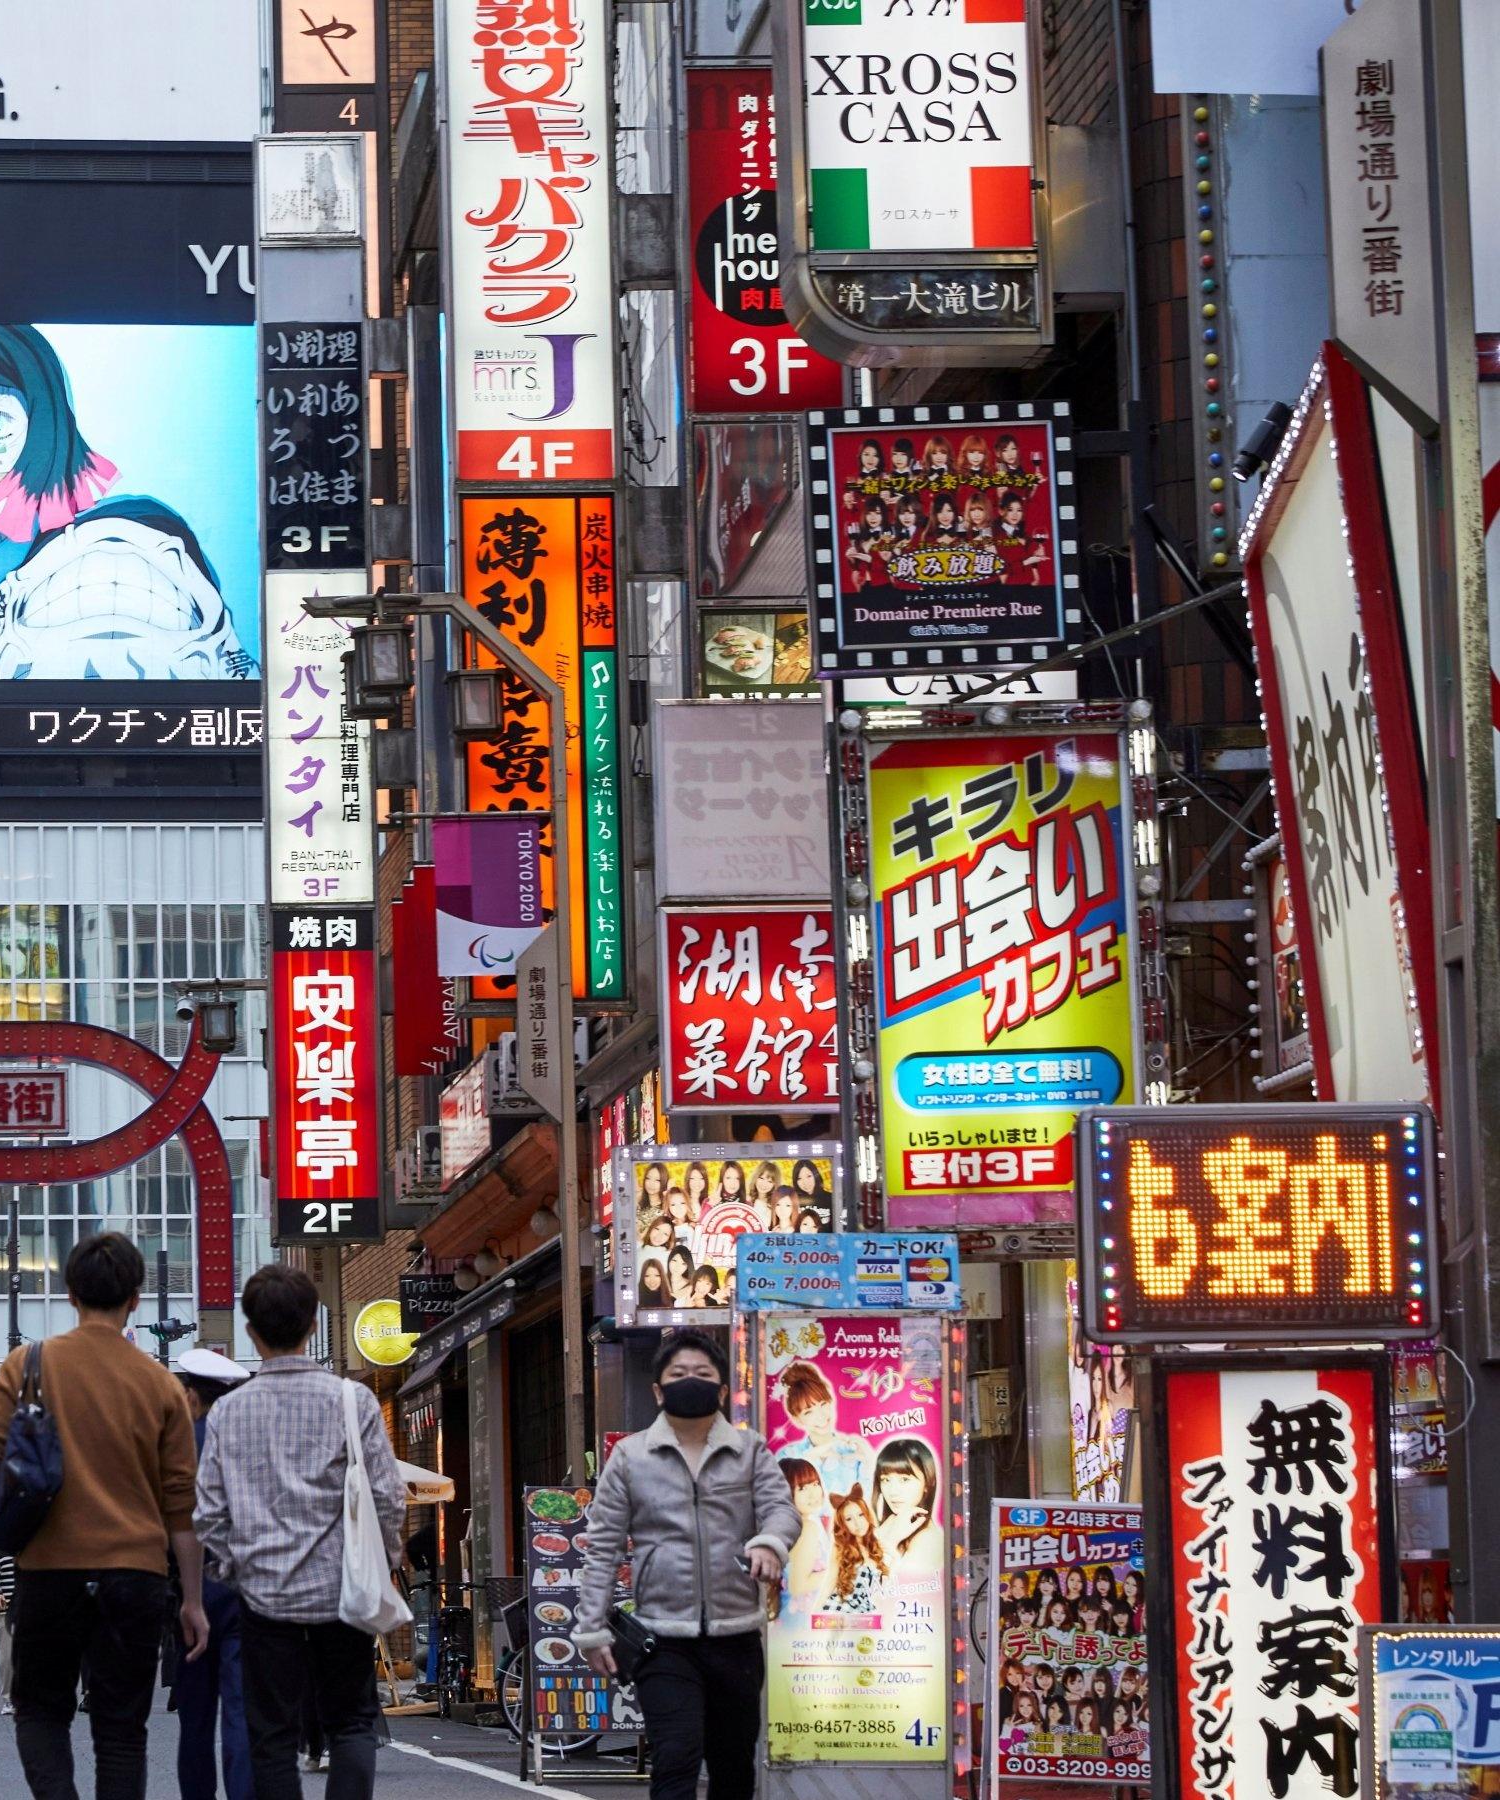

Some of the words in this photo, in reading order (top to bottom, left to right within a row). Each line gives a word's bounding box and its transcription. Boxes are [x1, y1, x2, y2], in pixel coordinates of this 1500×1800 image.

[810, 52, 1018, 96] XROSS
[338, 98, 360, 126] 4
[840, 100, 1001, 144] CASA
[1355, 59, 1404, 317] 劇場通り一番街
[882, 208, 959, 221] クロスカーサ
[838, 281, 1033, 316] 第一大滝ビル
[267, 329, 358, 366] 小料理
[729, 337, 809, 396] 3F
[496, 436, 576, 479] 4F
[281, 526, 350, 553] 3F
[583, 514, 614, 630] 炭火串焼
[896, 553, 996, 578] 飲み放題
[855, 607, 929, 623] Domaine
[932, 604, 1006, 620] Premiere
[1010, 602, 1043, 617] Rue
[280, 664, 330, 838] バンタイ
[892, 738, 1077, 863] キラリ
[281, 861, 361, 872] RESTAURANT
[291, 850, 353, 860] BAN-THAI
[517, 829, 533, 881] TOKYO
[304, 878, 340, 897] 3F
[519, 884, 535, 922] 2020
[892, 812, 1106, 1002] 出会い
[289, 916, 357, 948] 焼肉
[984, 922, 1120, 1043] カフェ
[293, 969, 358, 1180] 安楽亭
[922, 1059, 1094, 1087] 女性は全て無料!
[909, 1149, 1056, 1185] 受付3F
[303, 1203, 354, 1234] 2F
[863, 1240, 945, 1257] カードOK!
[864, 1264, 894, 1275] VISA
[1019, 1509, 1040, 1525] 3F
[1004, 1533, 1088, 1567] 出会い
[1087, 1540, 1129, 1561] カフェ
[1246, 1399, 1360, 1800] 無料案内
[905, 1718, 942, 1747] 4F
